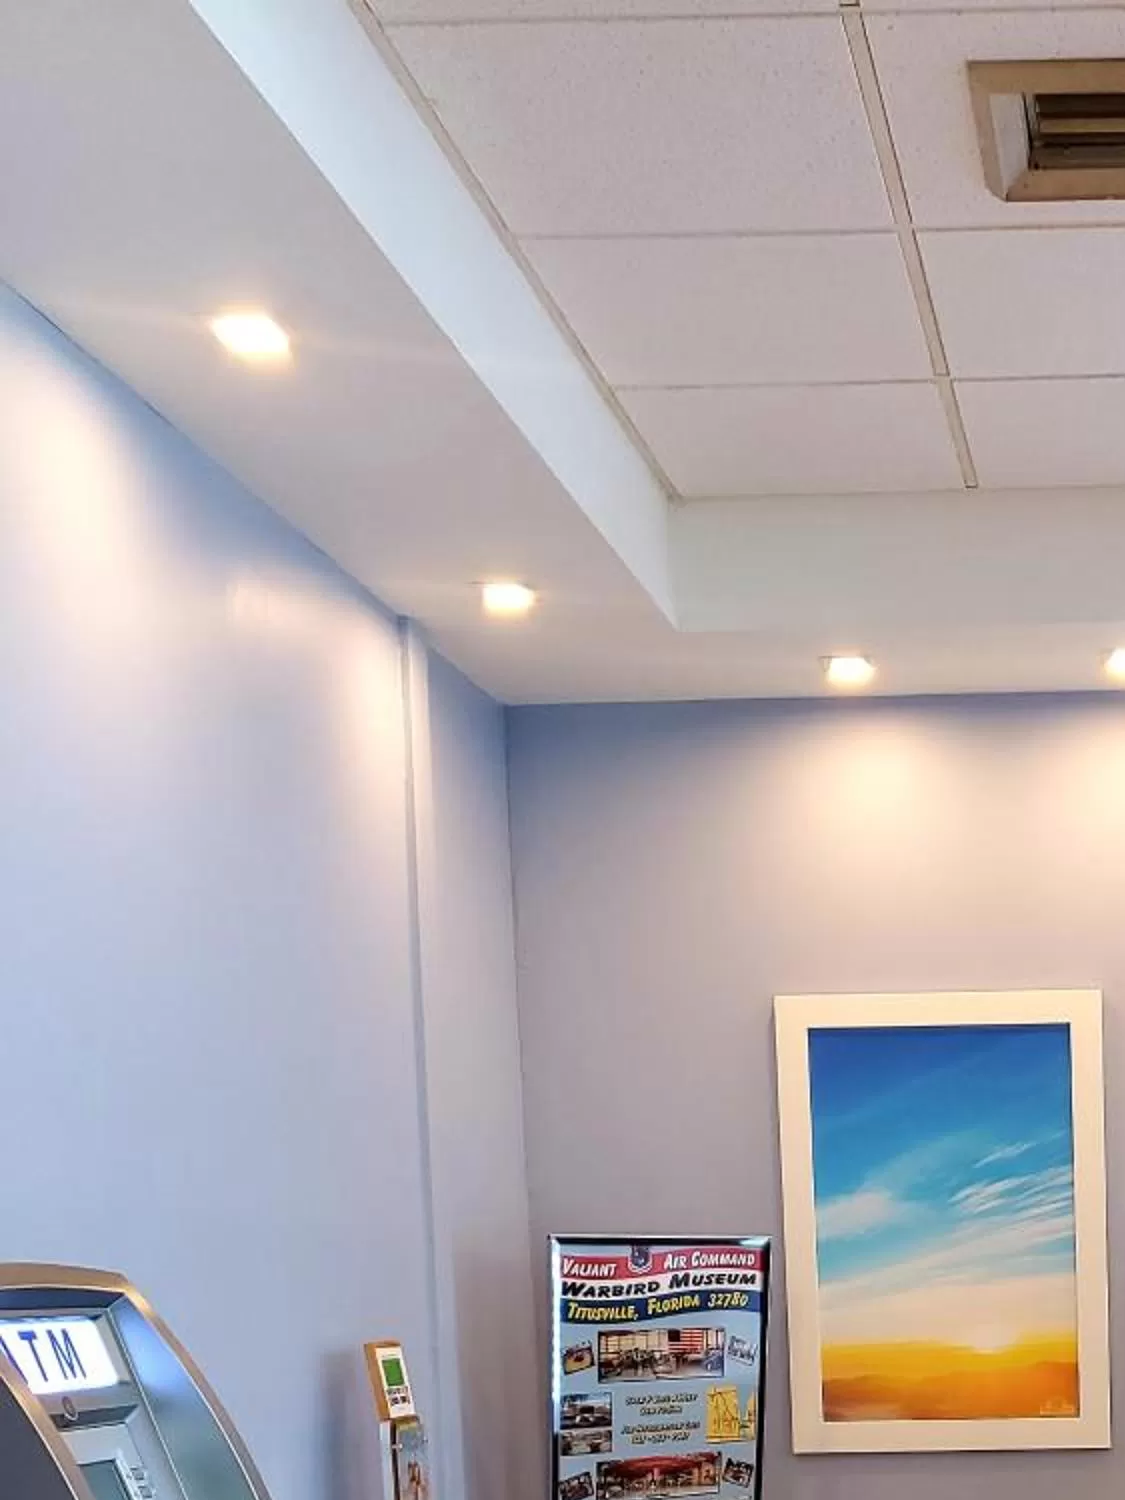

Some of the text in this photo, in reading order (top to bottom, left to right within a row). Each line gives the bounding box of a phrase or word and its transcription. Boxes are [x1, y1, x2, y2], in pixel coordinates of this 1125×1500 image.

[562, 1250, 755, 1277] VALIANT AIR COMMAND
[561, 1272, 756, 1299] WARBIRD MUSEUM
[567, 1292, 749, 1321] TITUSVILLE, FLORIDA 32780
